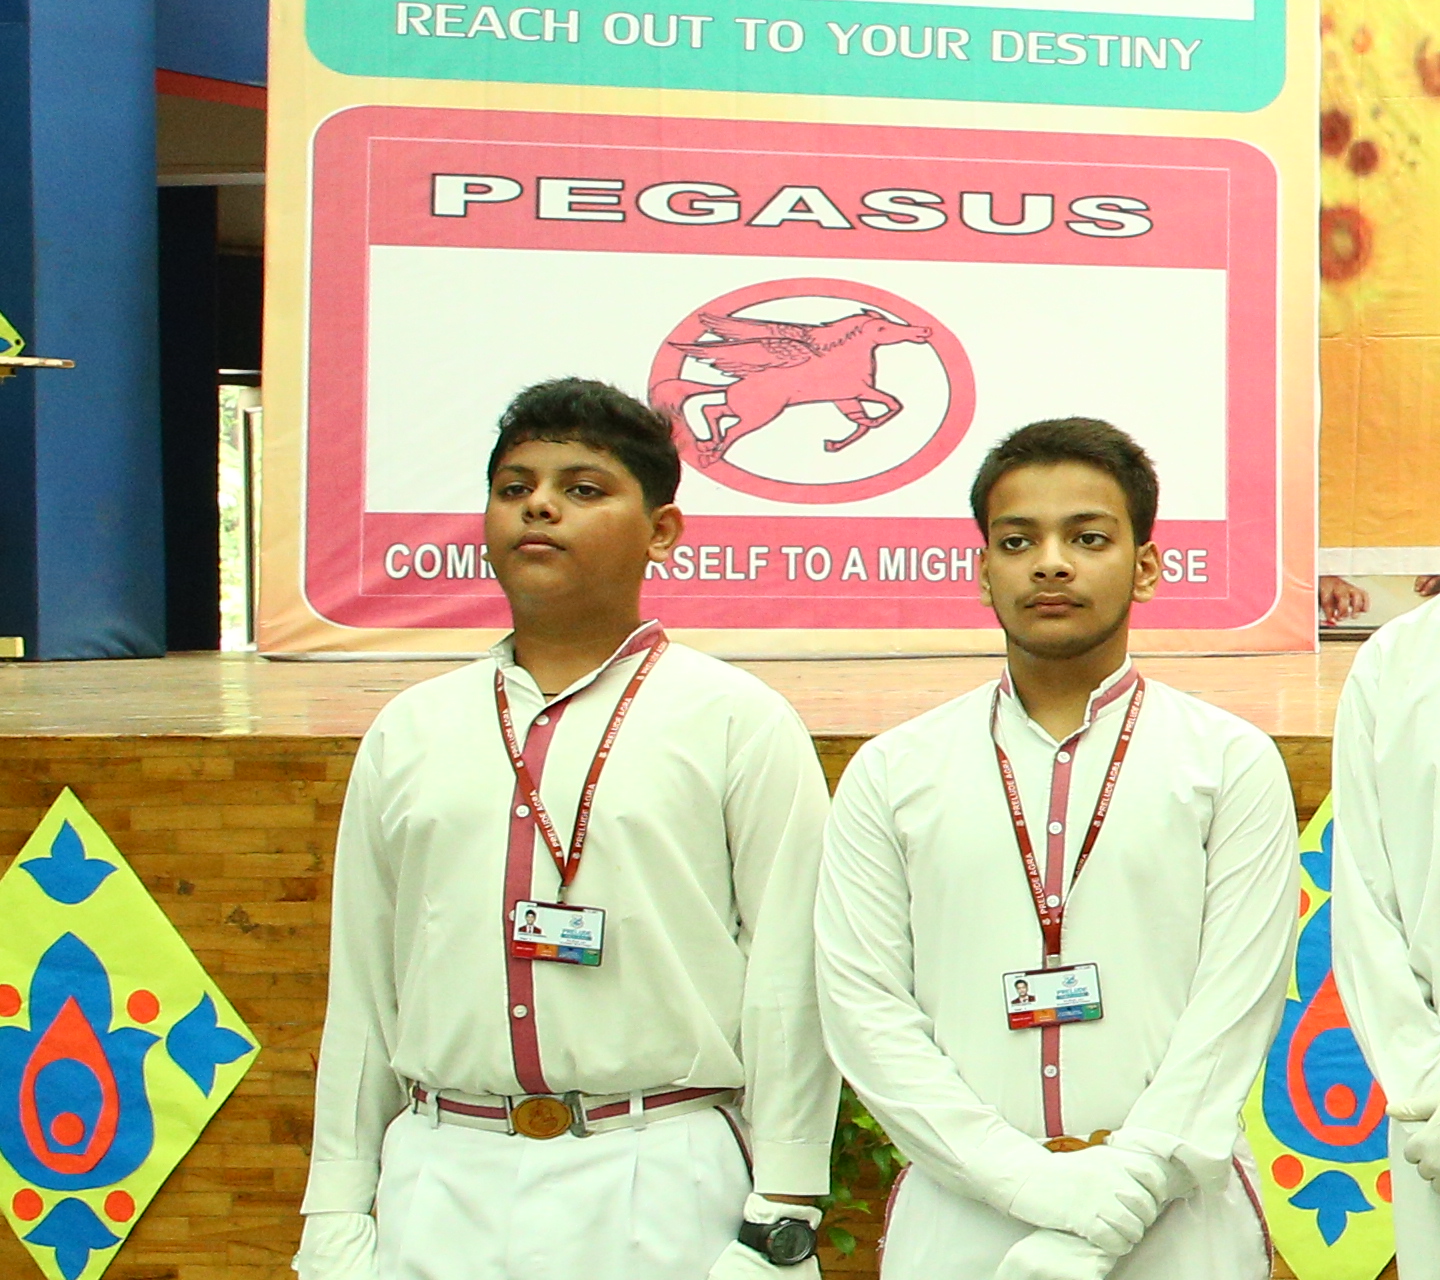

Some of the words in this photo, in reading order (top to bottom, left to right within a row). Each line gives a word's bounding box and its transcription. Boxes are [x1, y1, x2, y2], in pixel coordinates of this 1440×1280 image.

[396, 1, 580, 46] REACH
[602, 9, 716, 53] OUT
[738, 16, 806, 56] TO
[826, 21, 970, 62] YOUR
[990, 28, 1203, 73] DESTINY
[430, 172, 1154, 239] PEGASUS
[781, 546, 832, 582] TO
[842, 547, 868, 581] A
[575, 809, 589, 848] PRELUDE
[584, 783, 596, 808] AGRA
[1098, 780, 1115, 818] PRELUDE
[1109, 760, 1122, 779] AGRA
[1025, 852, 1038, 875] AGRA
[1032, 876, 1047, 915] PRELUDE
